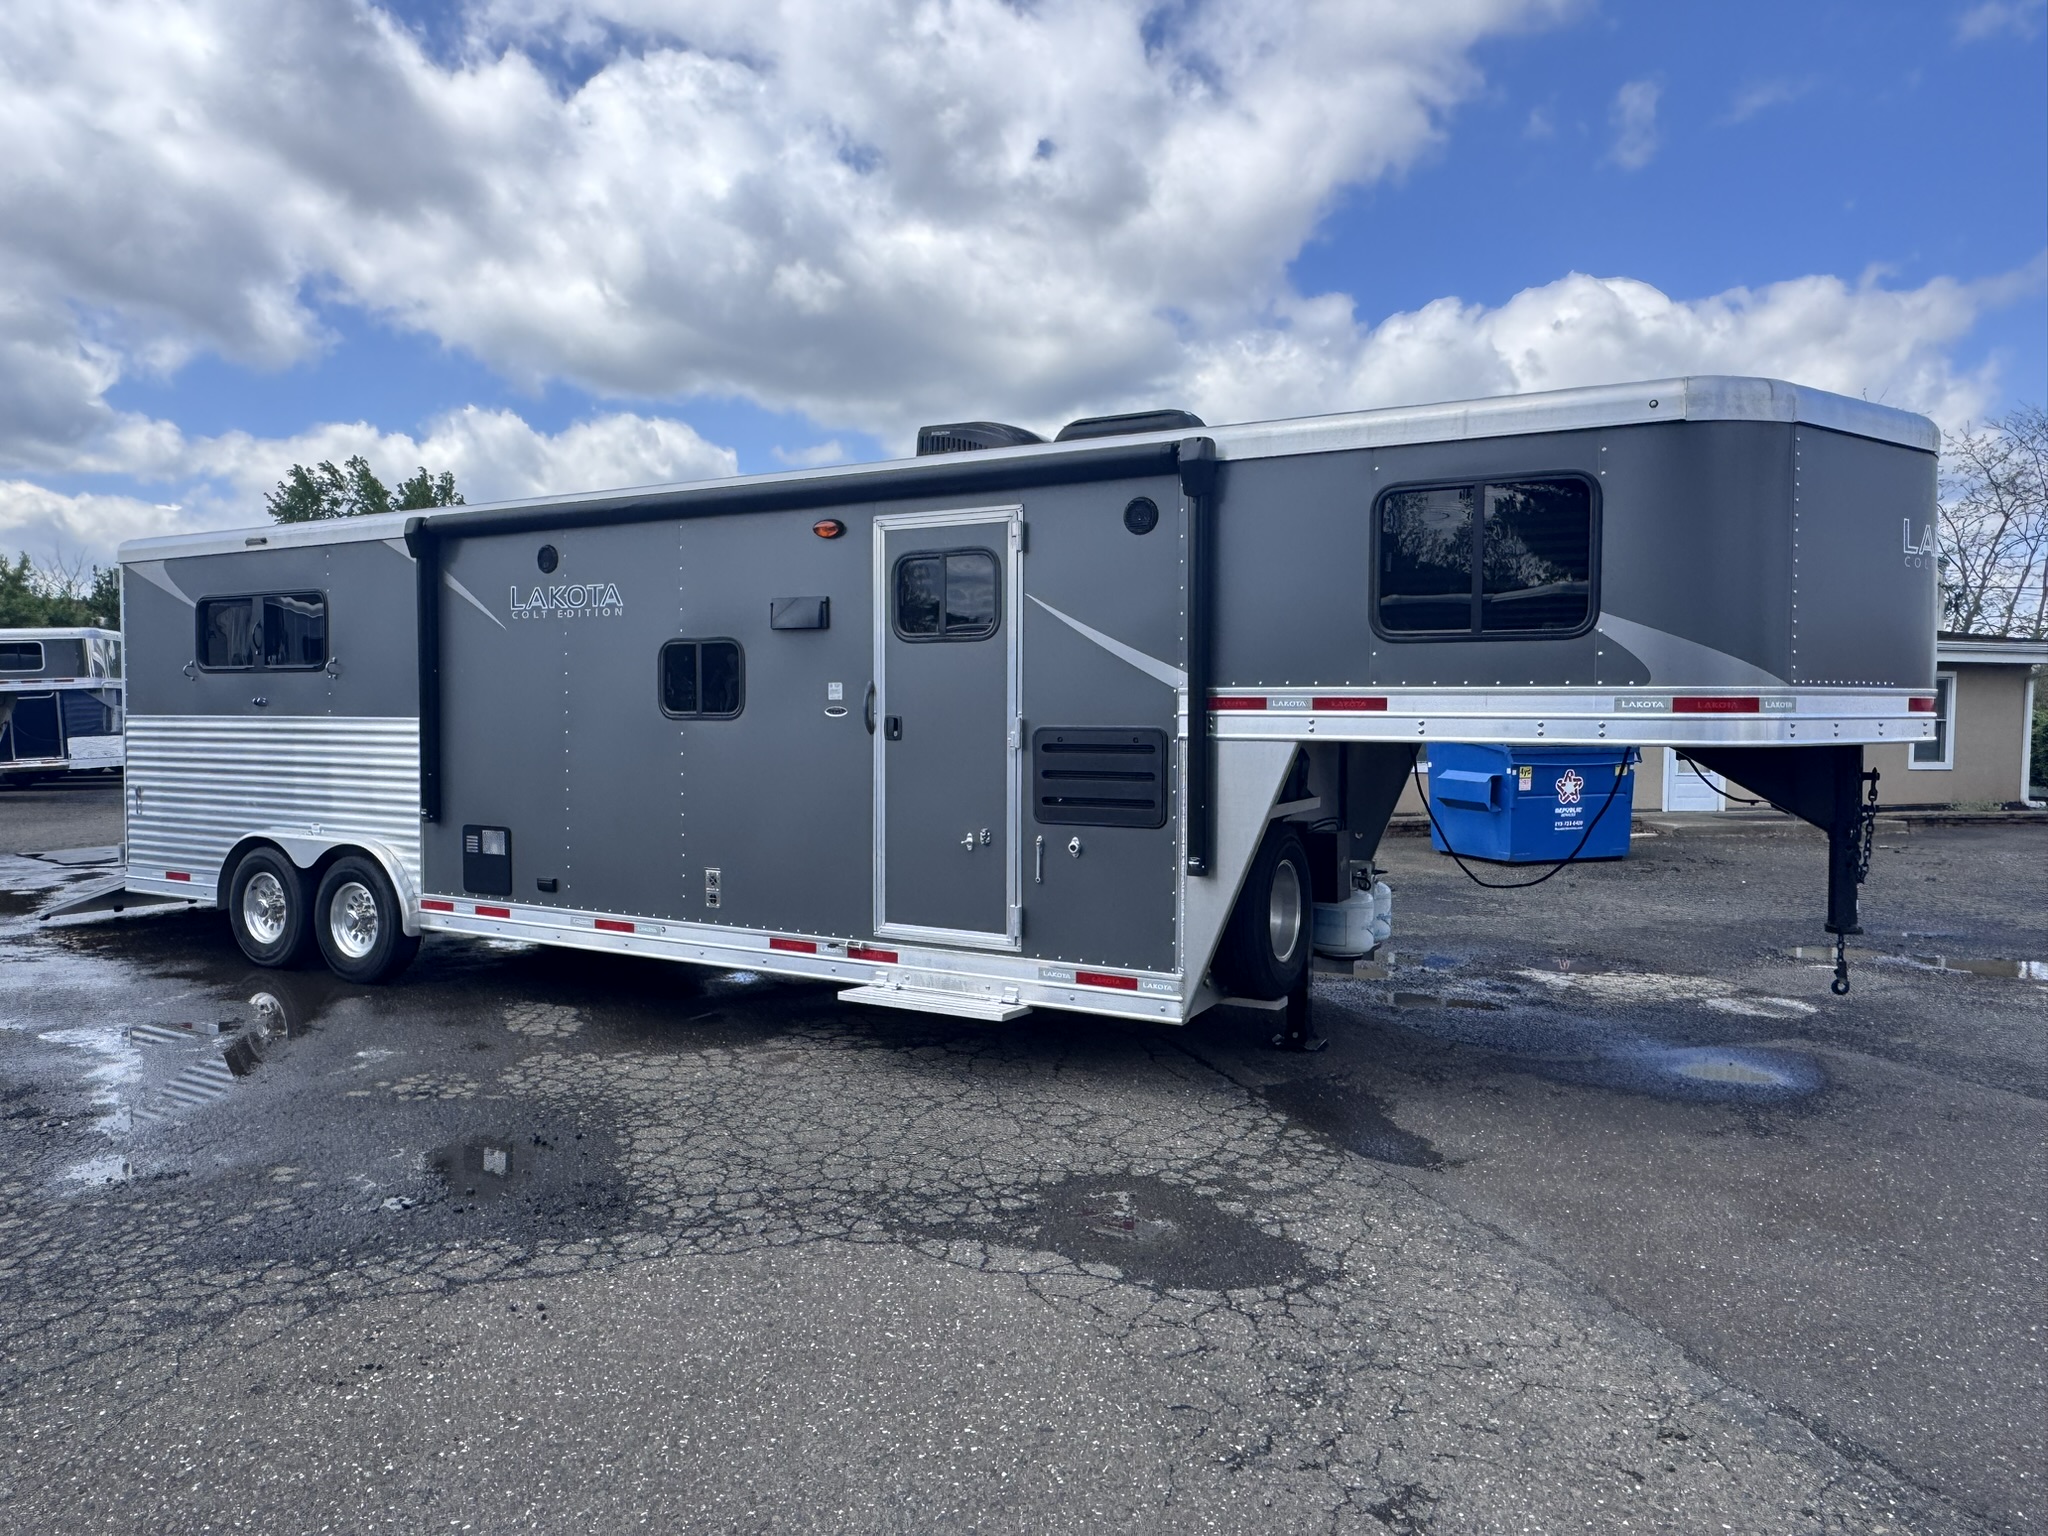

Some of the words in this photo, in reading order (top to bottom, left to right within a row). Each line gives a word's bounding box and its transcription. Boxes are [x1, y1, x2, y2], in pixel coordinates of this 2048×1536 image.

[510, 583, 624, 610] LAKOTA
[511, 610, 548, 619] COLT
[557, 607, 623, 618] EDITION
[1621, 700, 1665, 709] LAKOTA
[1043, 970, 1071, 979] LAKOTA
[1142, 982, 1173, 992] LAKOTA
